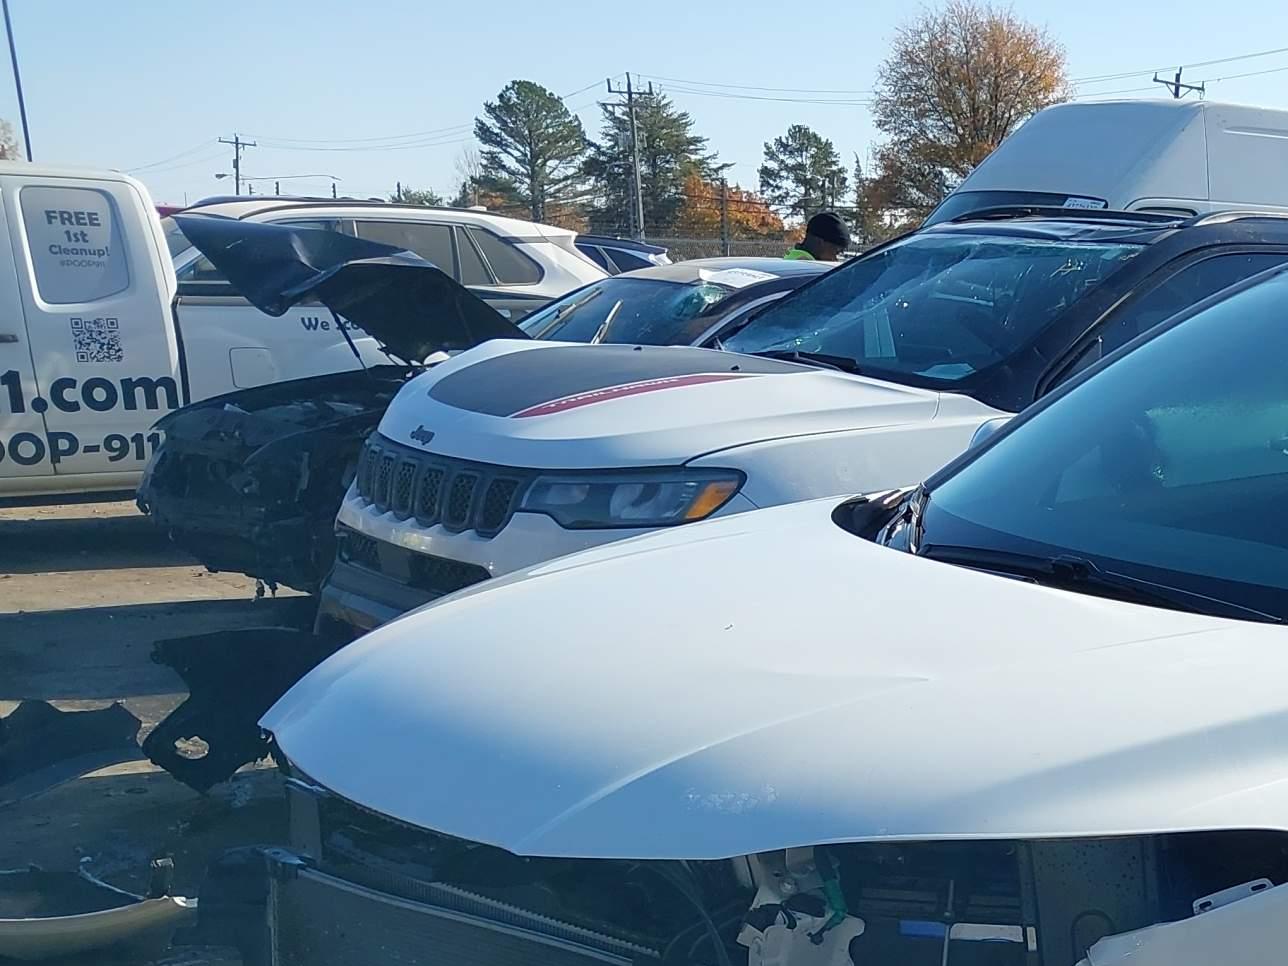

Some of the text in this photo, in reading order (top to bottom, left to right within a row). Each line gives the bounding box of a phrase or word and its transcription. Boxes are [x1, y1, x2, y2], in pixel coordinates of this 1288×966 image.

[44, 210, 101, 227] FREE
[64, 230, 89, 243] 1st
[48, 244, 110, 258] Cleanup!
[301, 316, 330, 331] We
